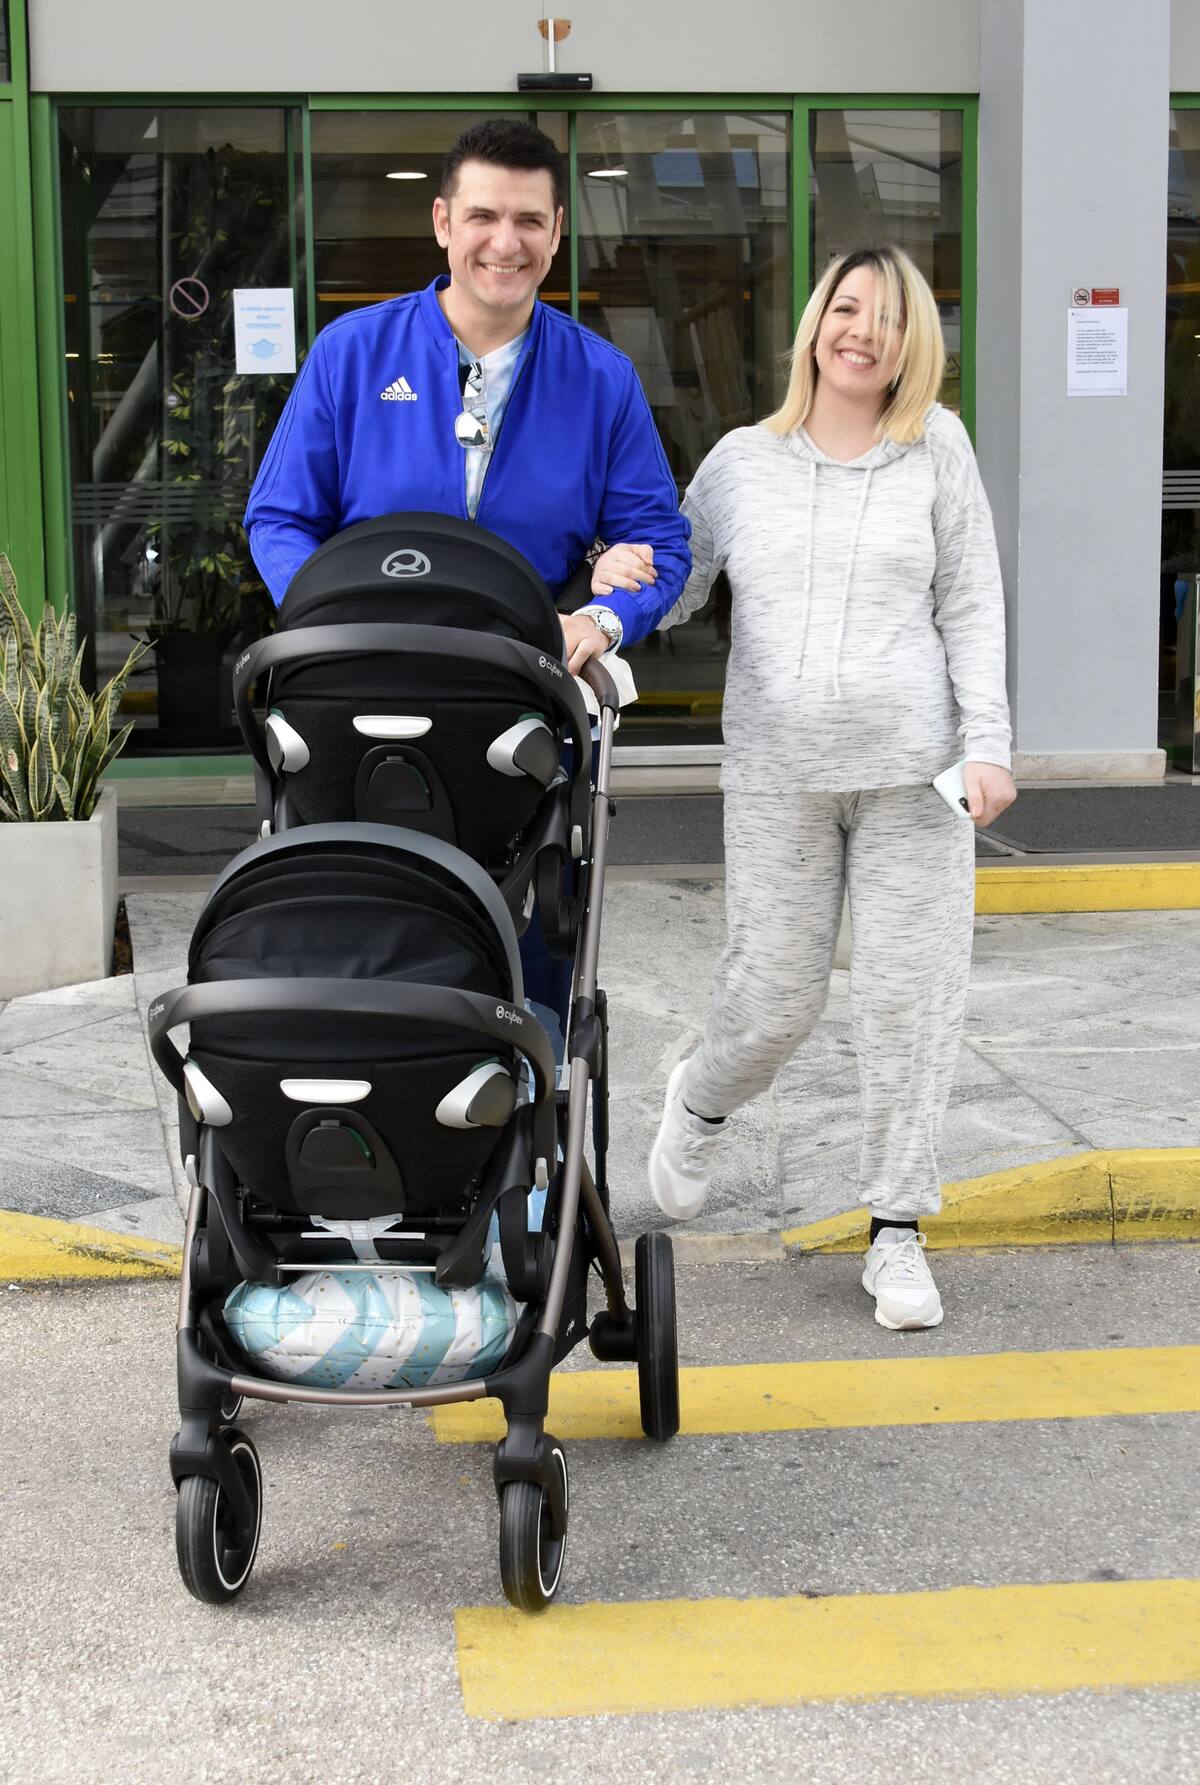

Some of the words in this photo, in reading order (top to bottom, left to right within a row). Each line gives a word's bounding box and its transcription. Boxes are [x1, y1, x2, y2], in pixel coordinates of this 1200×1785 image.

[380, 391, 418, 401] adidas
[547, 662, 563, 679] cybex
[504, 1009, 523, 1025] cybex
